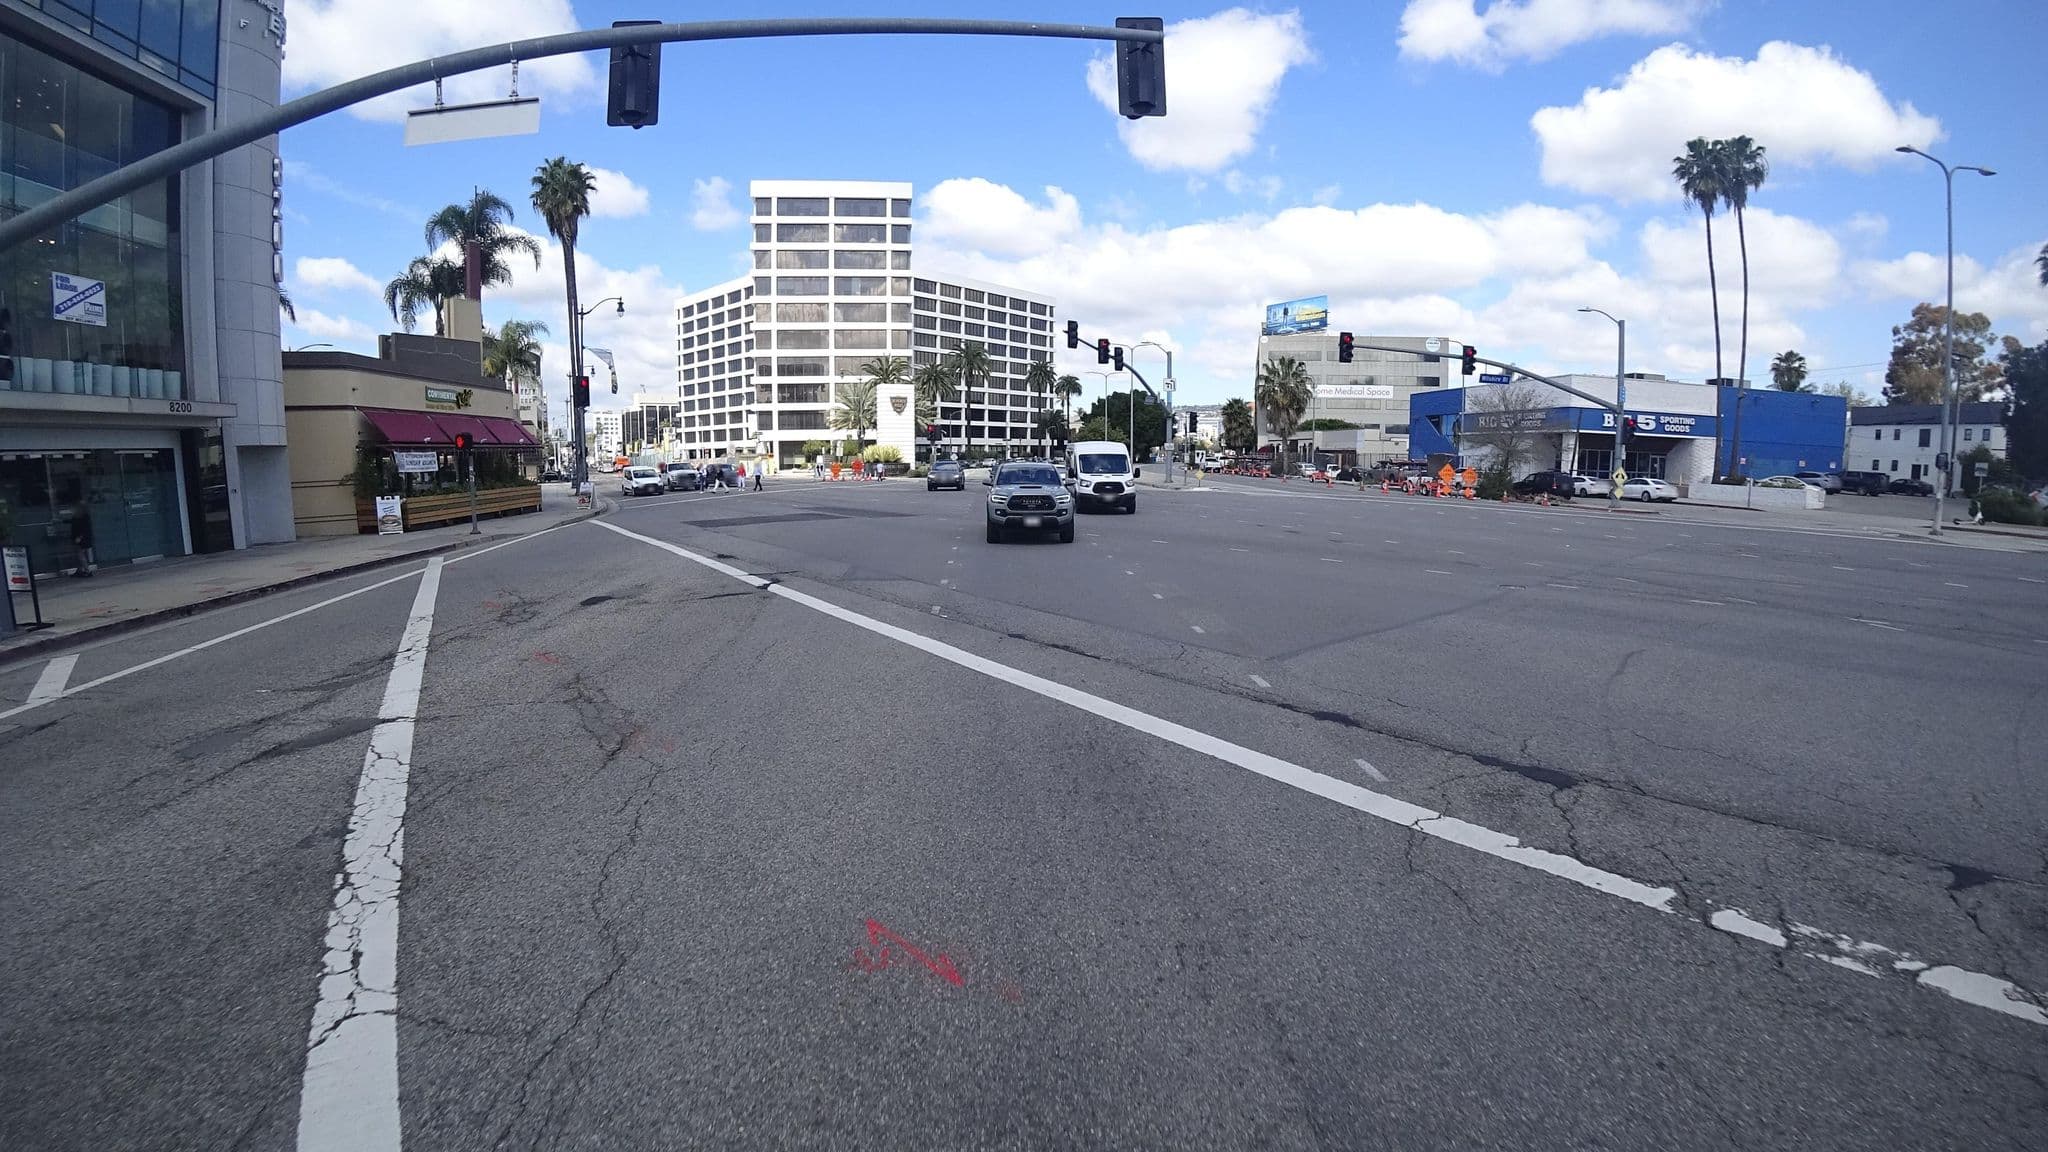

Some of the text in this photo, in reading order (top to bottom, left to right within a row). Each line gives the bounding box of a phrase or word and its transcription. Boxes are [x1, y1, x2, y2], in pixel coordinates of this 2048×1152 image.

[1335, 387, 1365, 395] Medical
[1367, 387, 1390, 396] Space
[169, 401, 192, 413] 8200
[1637, 415, 1656, 430] 5
[1660, 416, 1695, 425] SPORTING
[1664, 424, 1690, 433] GOODS
